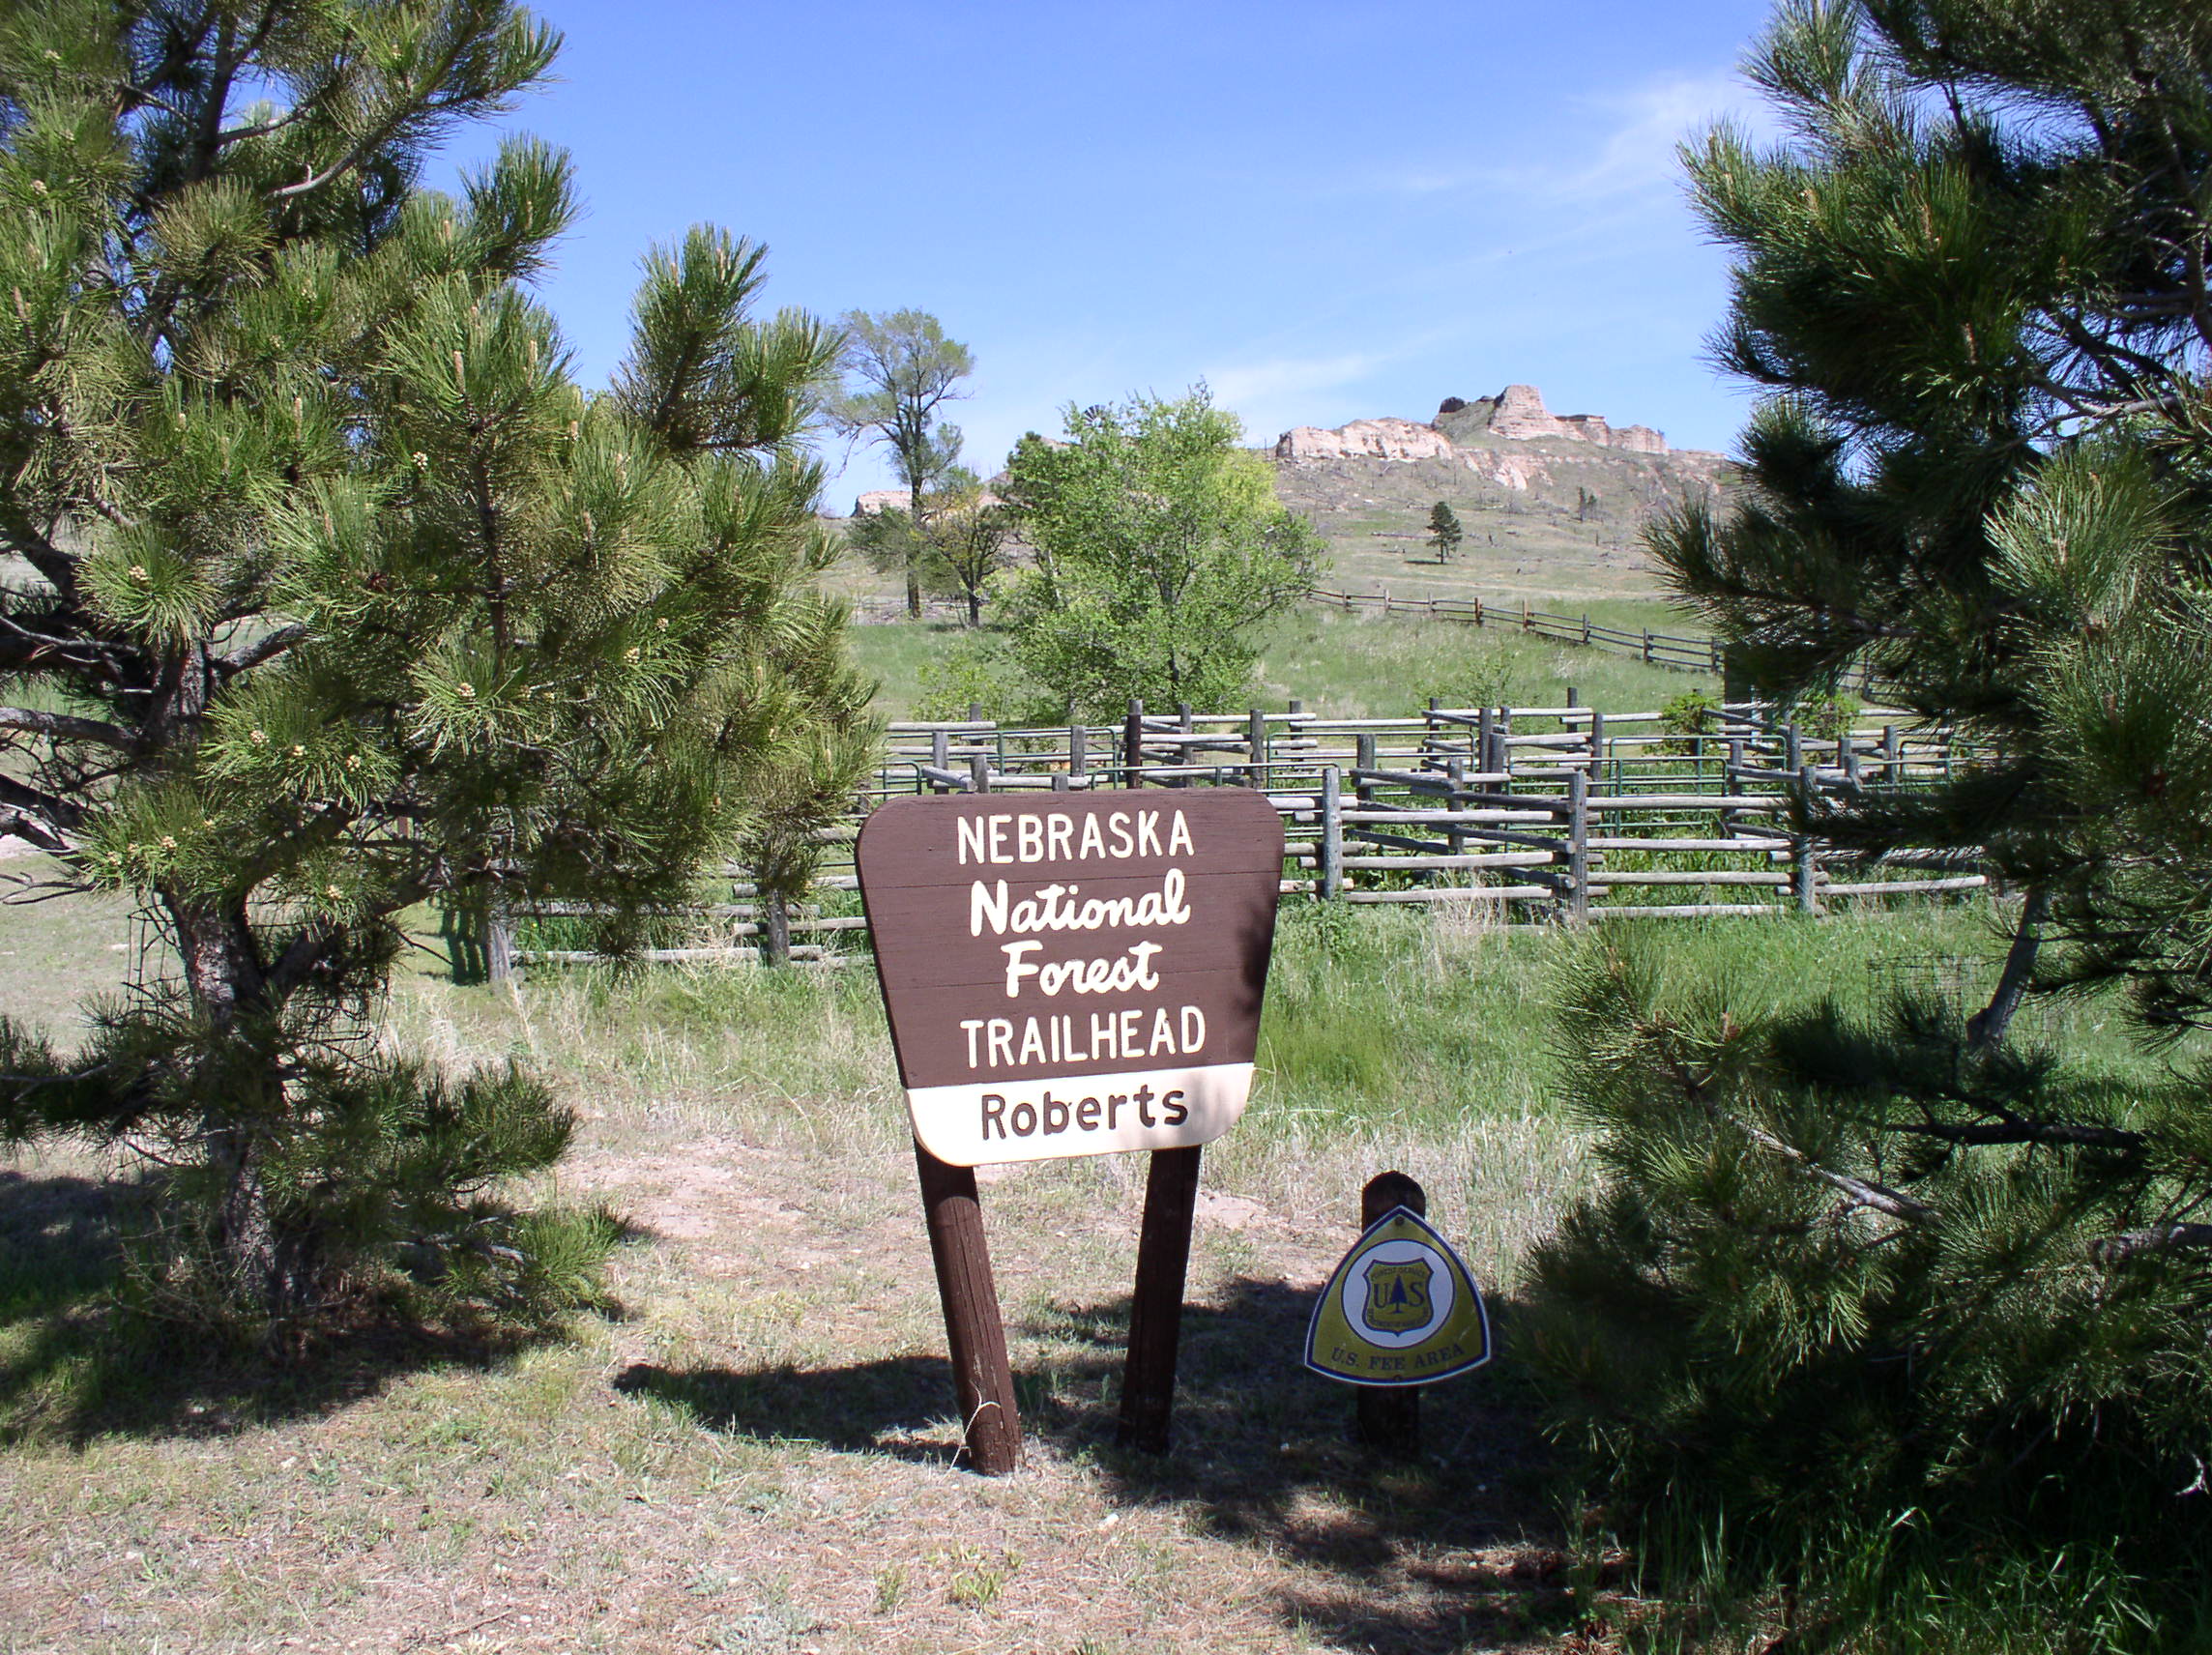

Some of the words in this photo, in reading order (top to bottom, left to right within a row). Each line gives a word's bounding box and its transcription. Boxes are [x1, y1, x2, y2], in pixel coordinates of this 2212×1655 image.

[957, 809, 1195, 865] NEBRASKA
[970, 867, 1191, 937] National
[1001, 939, 1163, 998] Forest
[959, 1004, 1207, 1068] TRAILHEAD
[980, 1084, 1189, 1141] Roberts
[1330, 1347, 1361, 1368] U.S.
[1367, 1355, 1406, 1371] FEE
[1413, 1343, 1466, 1370] AREA
